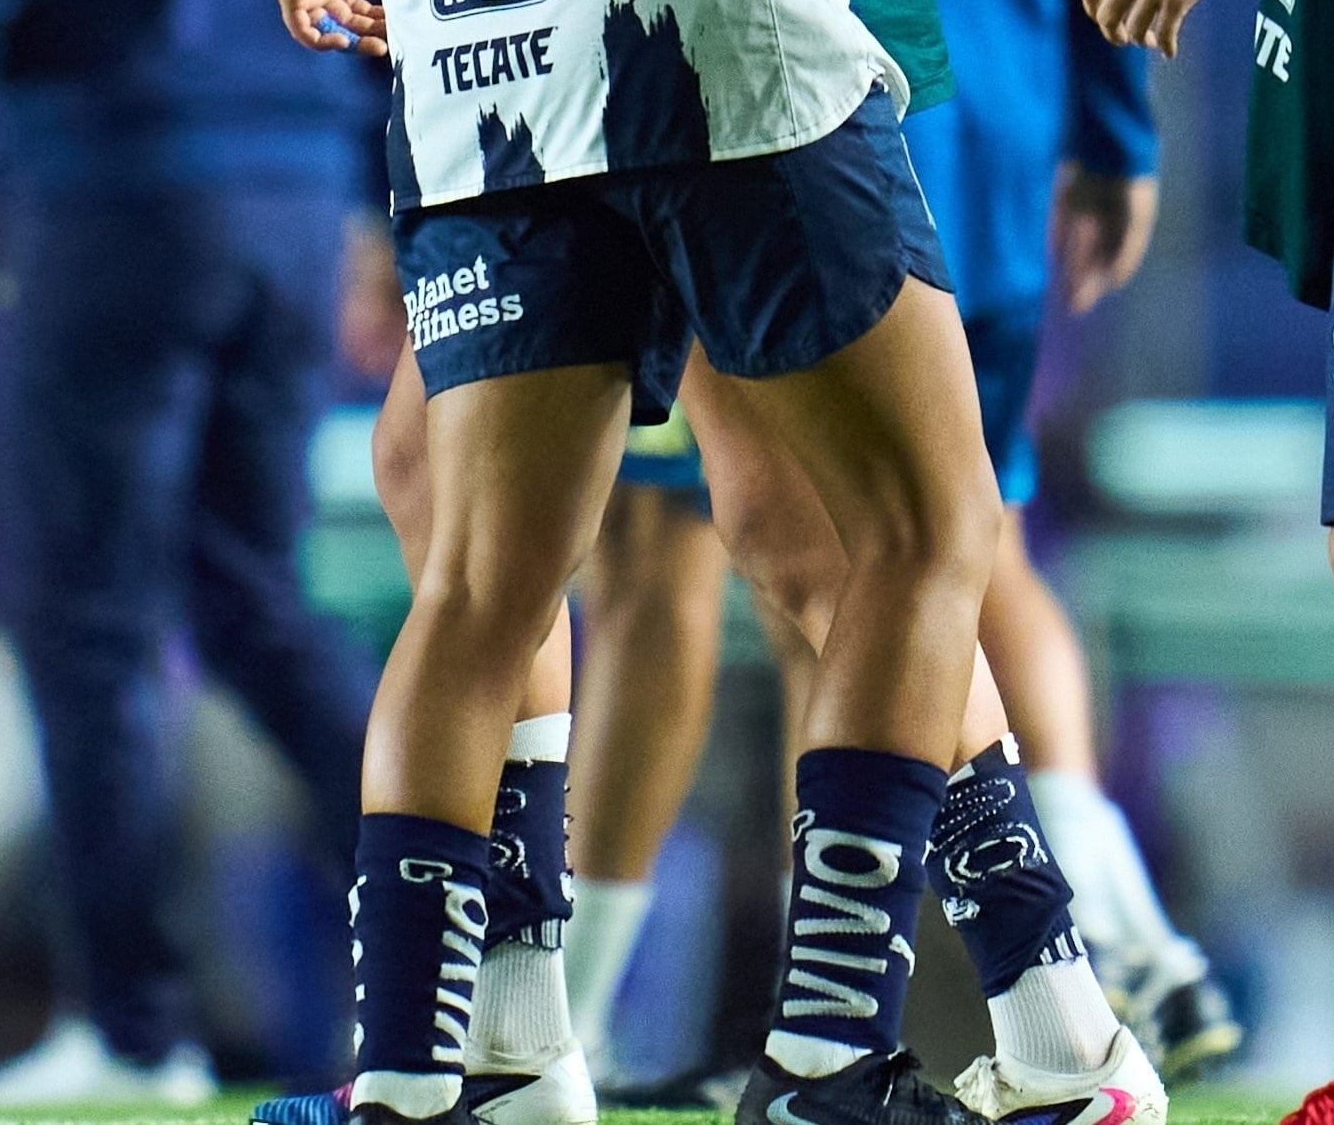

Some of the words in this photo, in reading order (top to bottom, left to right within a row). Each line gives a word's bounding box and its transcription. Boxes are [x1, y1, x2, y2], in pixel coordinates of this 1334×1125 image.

[432, 27, 554, 94] TECATE
[403, 255, 490, 331] planet
[414, 294, 524, 351] fitness
